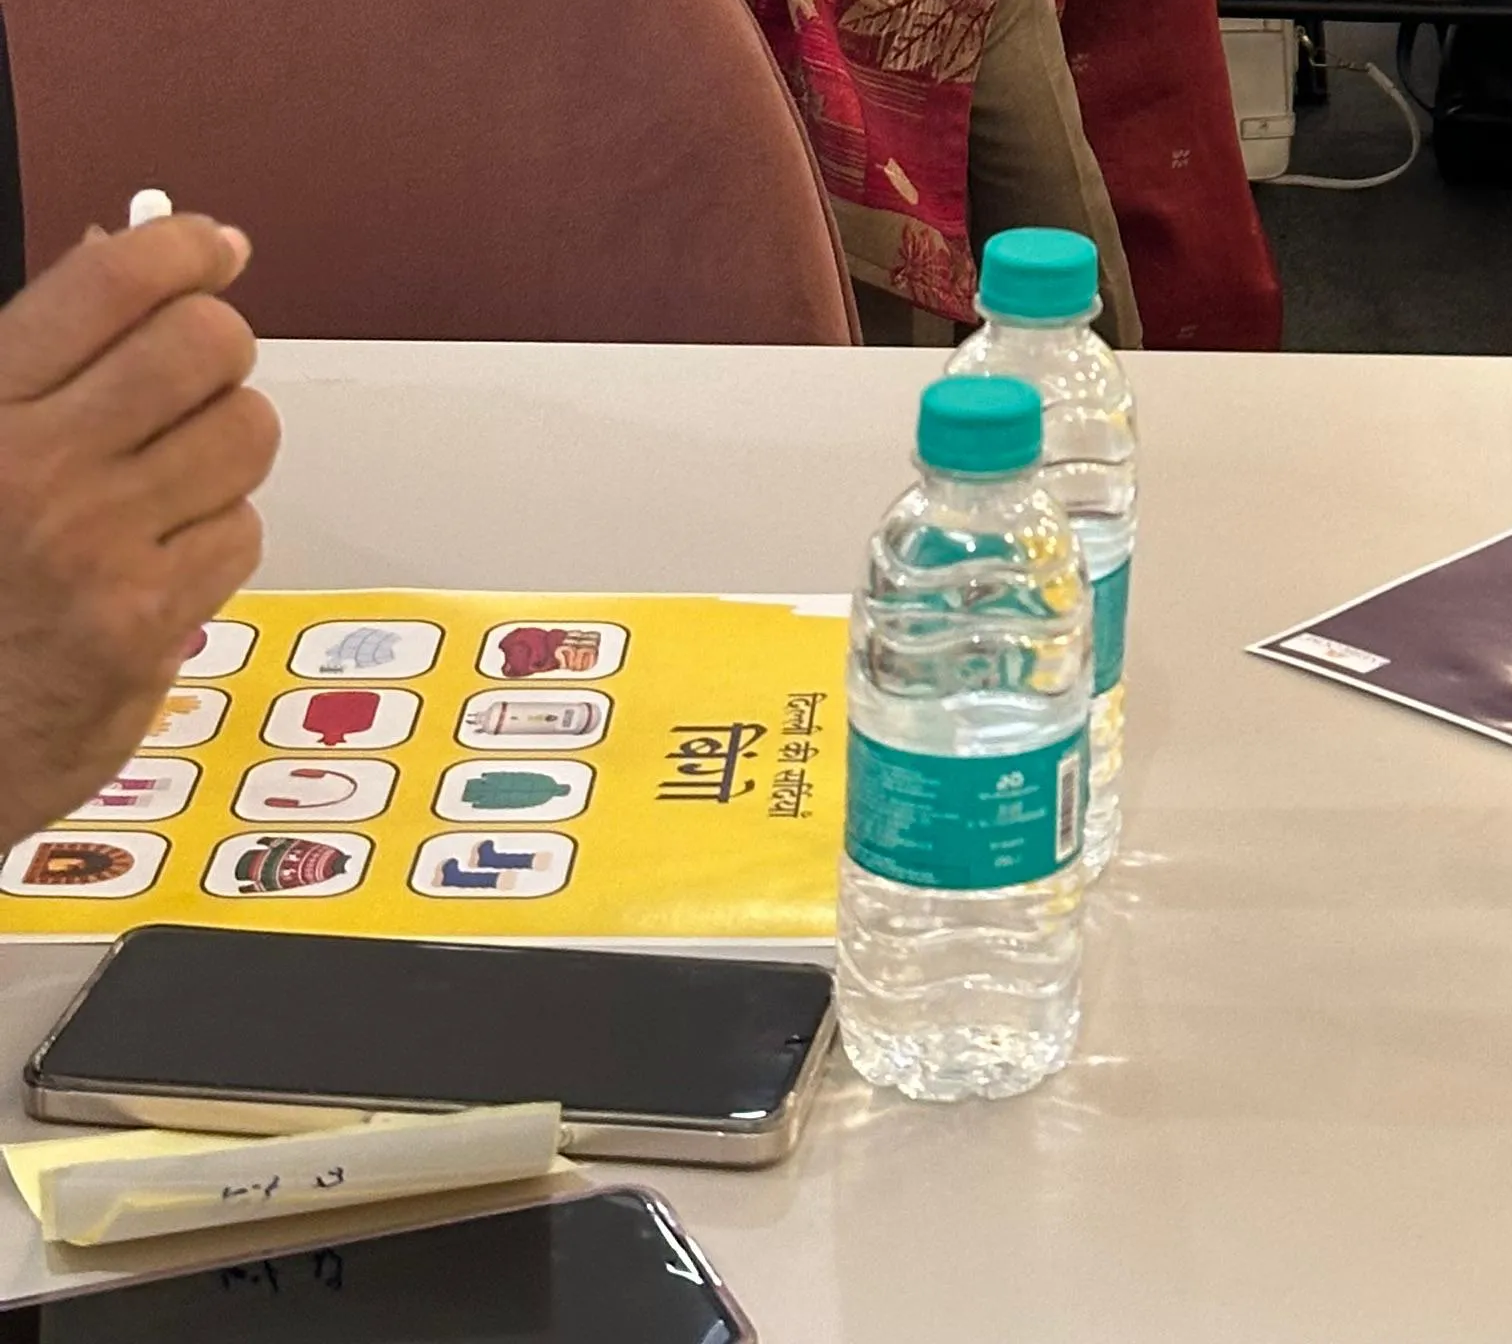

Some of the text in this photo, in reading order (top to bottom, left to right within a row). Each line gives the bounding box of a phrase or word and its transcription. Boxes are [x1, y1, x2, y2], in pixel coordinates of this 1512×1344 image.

[781, 691, 828, 736] दिल्ली
[654, 722, 768, 804] बिंगो
[777, 740, 820, 763] की
